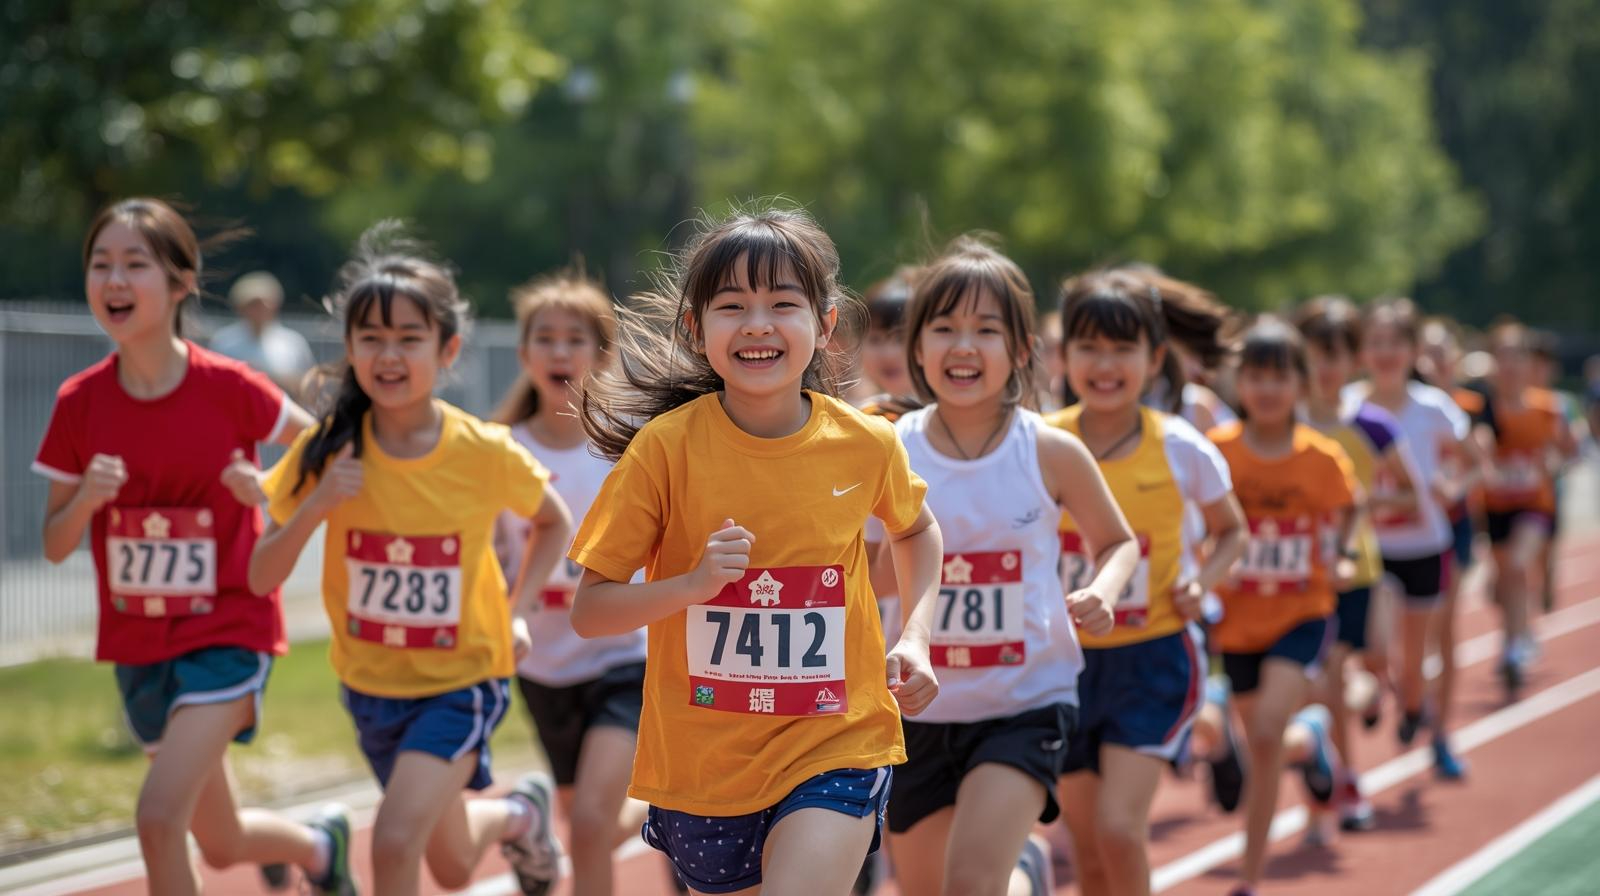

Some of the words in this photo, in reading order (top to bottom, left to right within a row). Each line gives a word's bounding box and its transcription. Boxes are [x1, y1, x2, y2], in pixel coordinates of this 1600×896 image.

[121, 544, 205, 583] 2775
[361, 567, 450, 614] 7283
[706, 611, 827, 668] 7412
